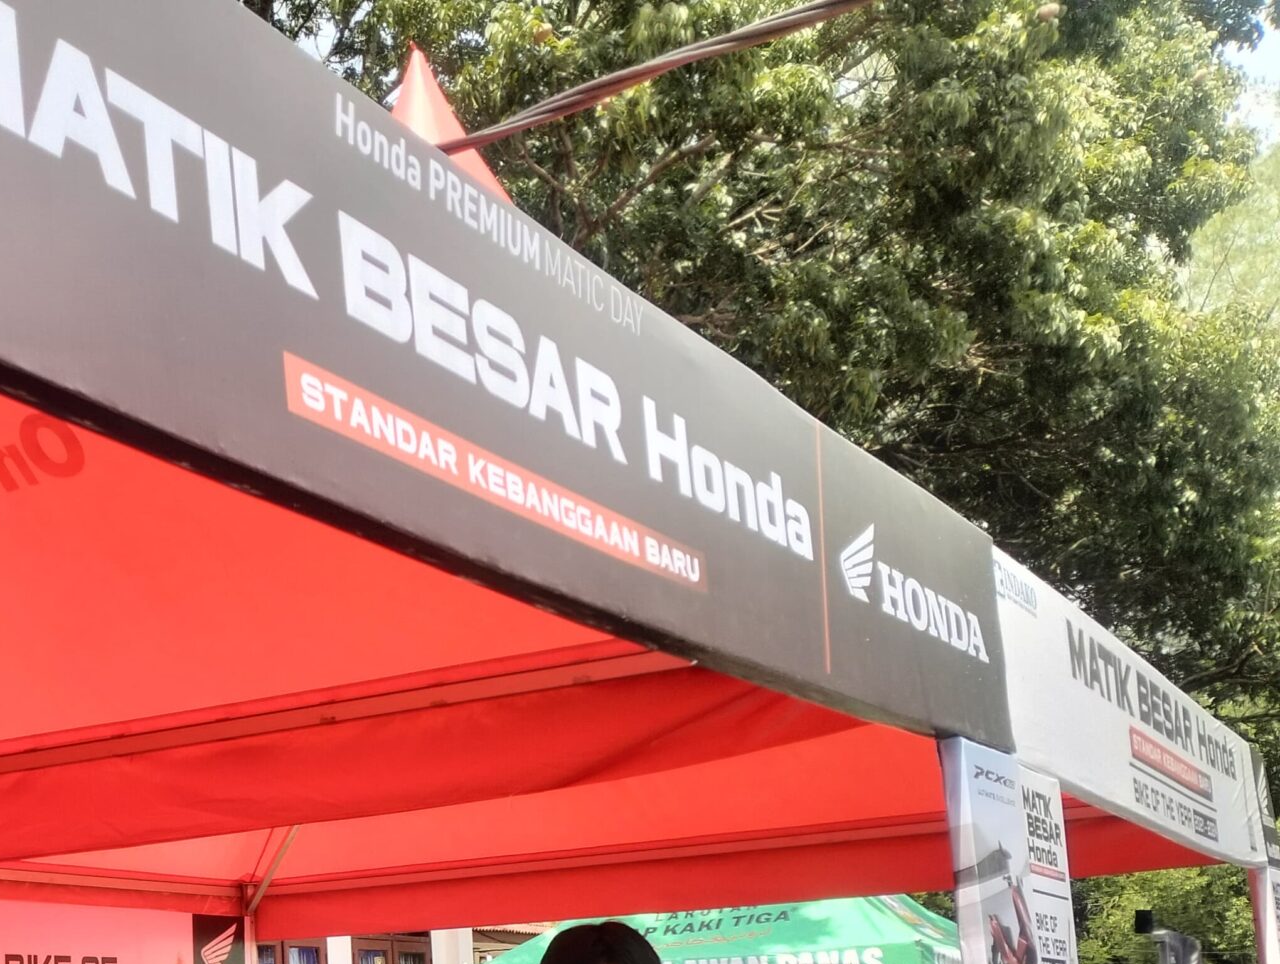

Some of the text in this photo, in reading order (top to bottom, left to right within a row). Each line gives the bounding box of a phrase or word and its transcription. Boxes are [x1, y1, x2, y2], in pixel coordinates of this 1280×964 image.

[335, 93, 644, 337] Honda PREMIUM MATIC DAY
[337, 209, 628, 464] BESAR
[642, 395, 814, 561] Honda
[300, 371, 701, 583] STANDAR KEBANGGAAN BARU
[877, 560, 990, 664] HONDA
[1066, 617, 1237, 781] MATIK BESAR Honda
[1022, 785, 1053, 821] MATIK
[1026, 815, 1063, 848] BESAR
[1028, 837, 1058, 868] Honda
[663, 918, 725, 936] KAKI
[732, 911, 791, 927] TIGA
